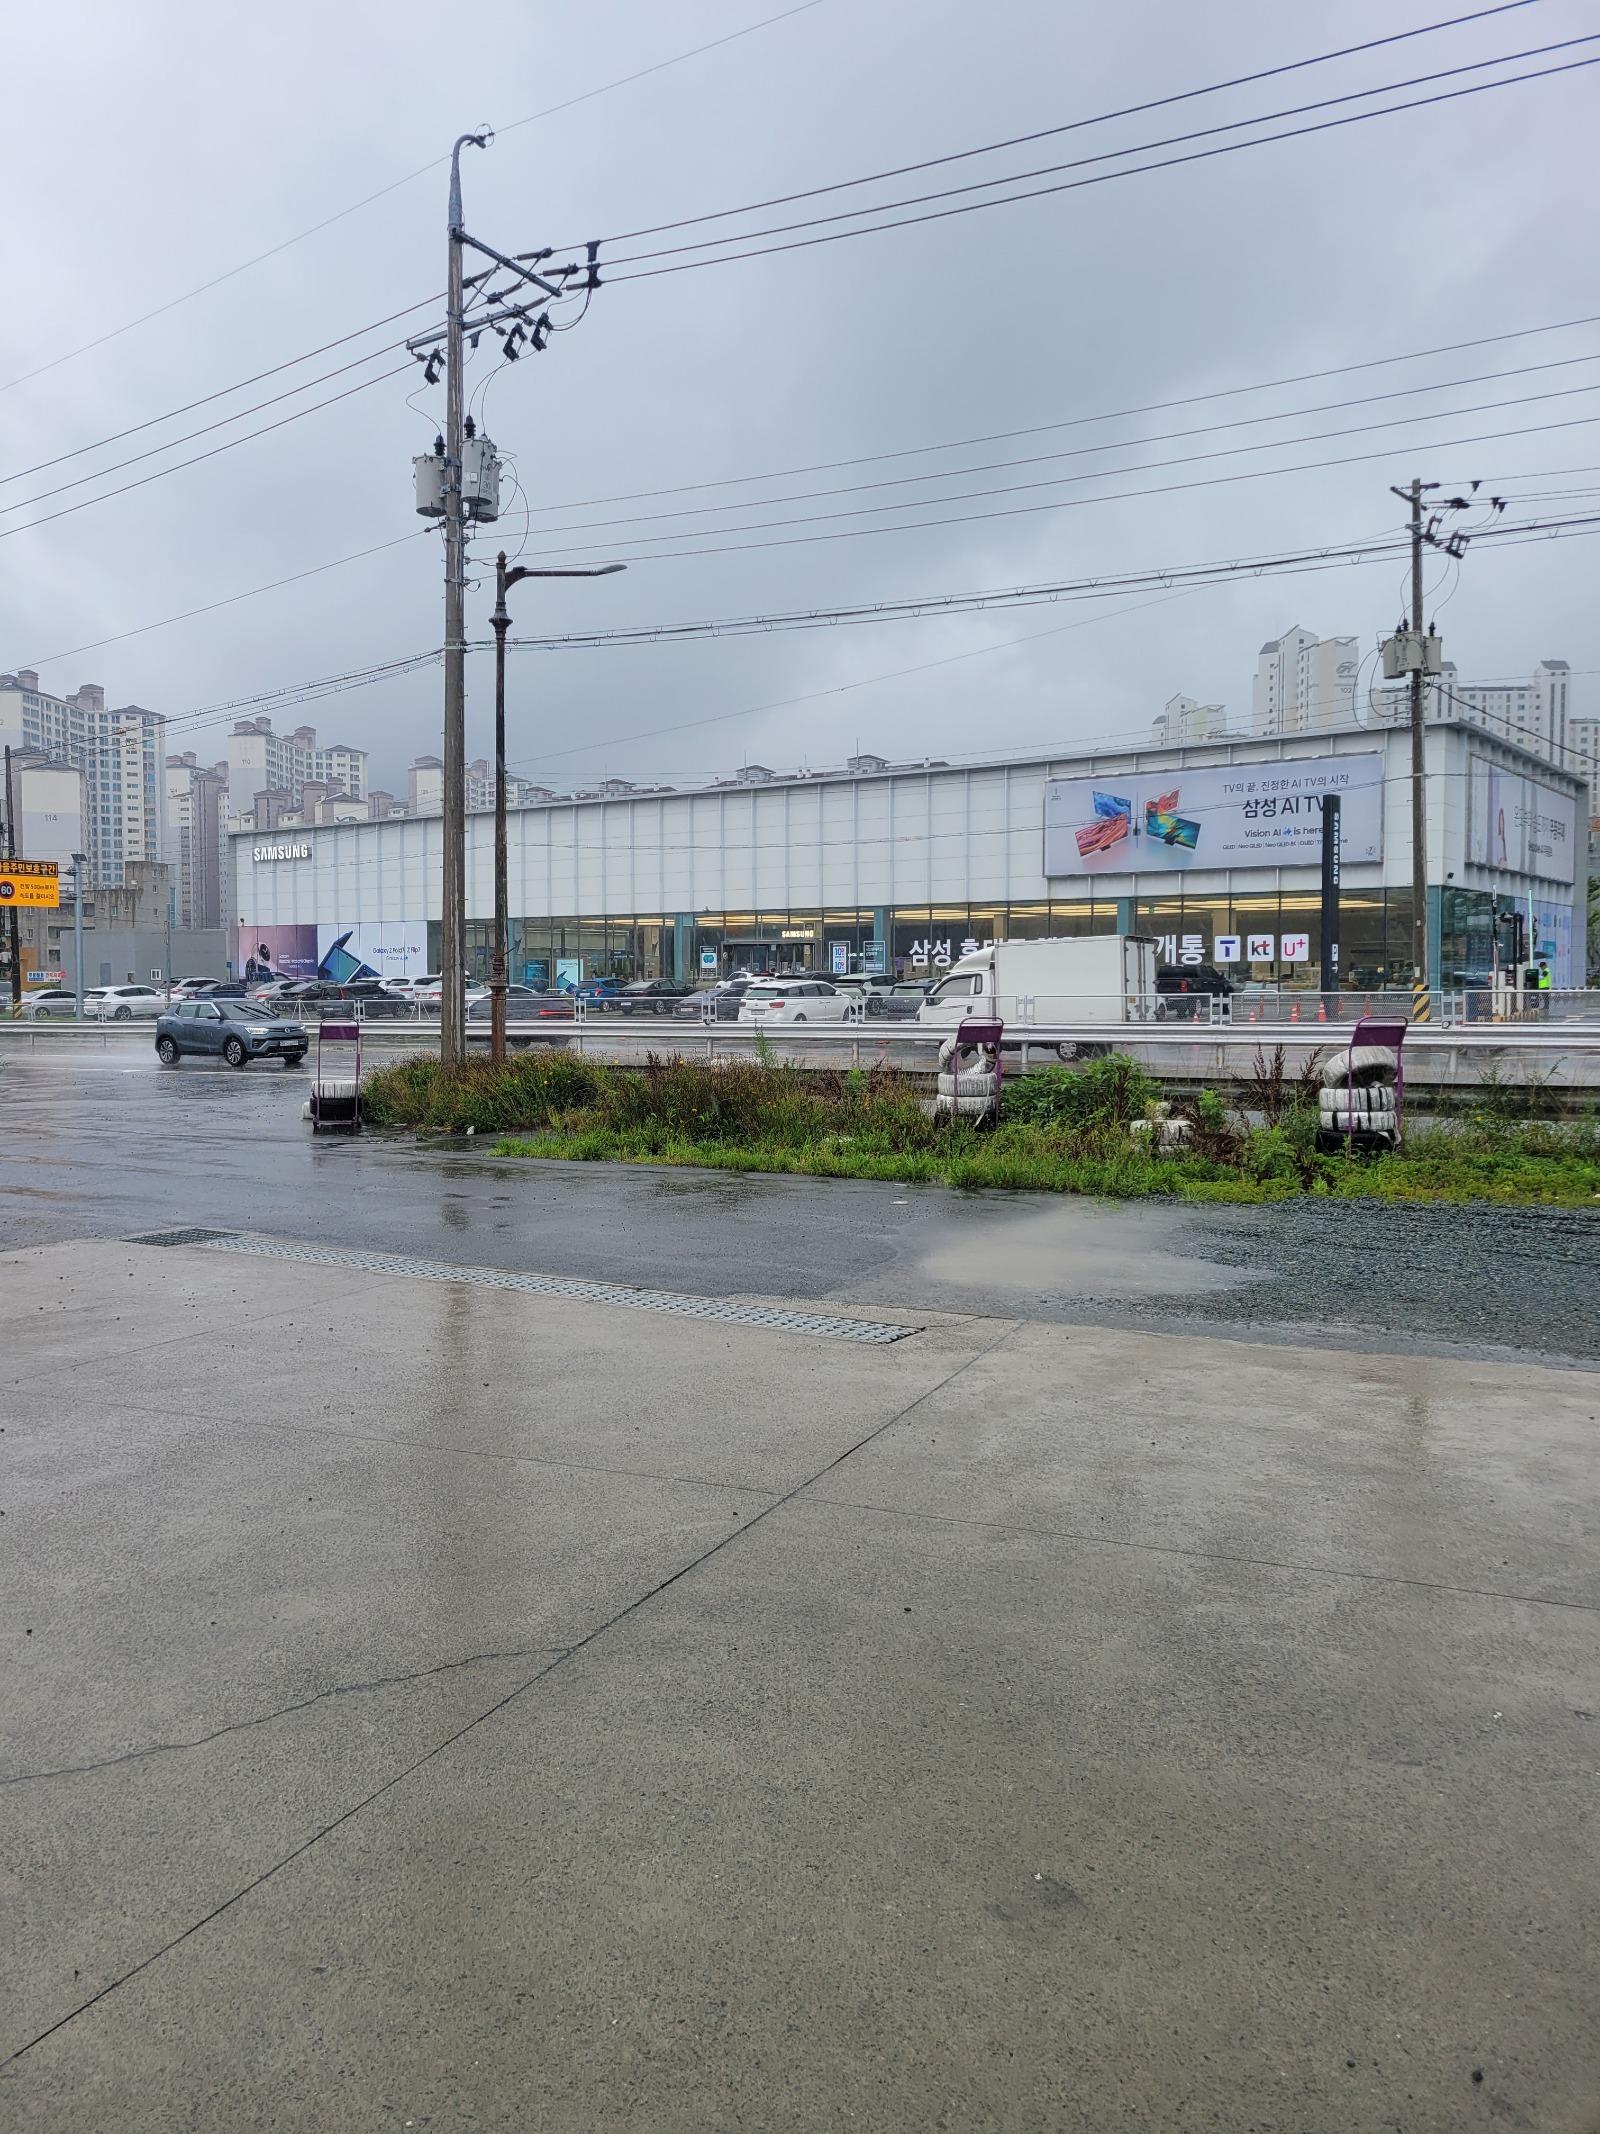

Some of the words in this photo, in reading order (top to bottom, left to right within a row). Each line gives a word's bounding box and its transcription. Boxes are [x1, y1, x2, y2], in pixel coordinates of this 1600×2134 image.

[1223, 783, 1244, 793] TV의
[1261, 779, 1290, 792] 진정한
[1291, 779, 1301, 788] AI
[1304, 776, 1327, 787] TV의
[1329, 774, 1350, 785] 시작
[1242, 797, 1277, 818] 삼성
[1281, 796, 1299, 814] AI
[1244, 829, 1271, 838] Vision
[1273, 829, 1281, 837] AI
[1293, 827, 1302, 835] is
[1303, 826, 1324, 835] here
[254, 844, 308, 861] SAMSUNG
[0, 885, 12, 895] 60
[781, 930, 814, 938] SAMSUNG
[908, 938, 952, 967] 삼성
[1152, 934, 1206, 965] 개통
[1251, 939, 1271, 956] kt
